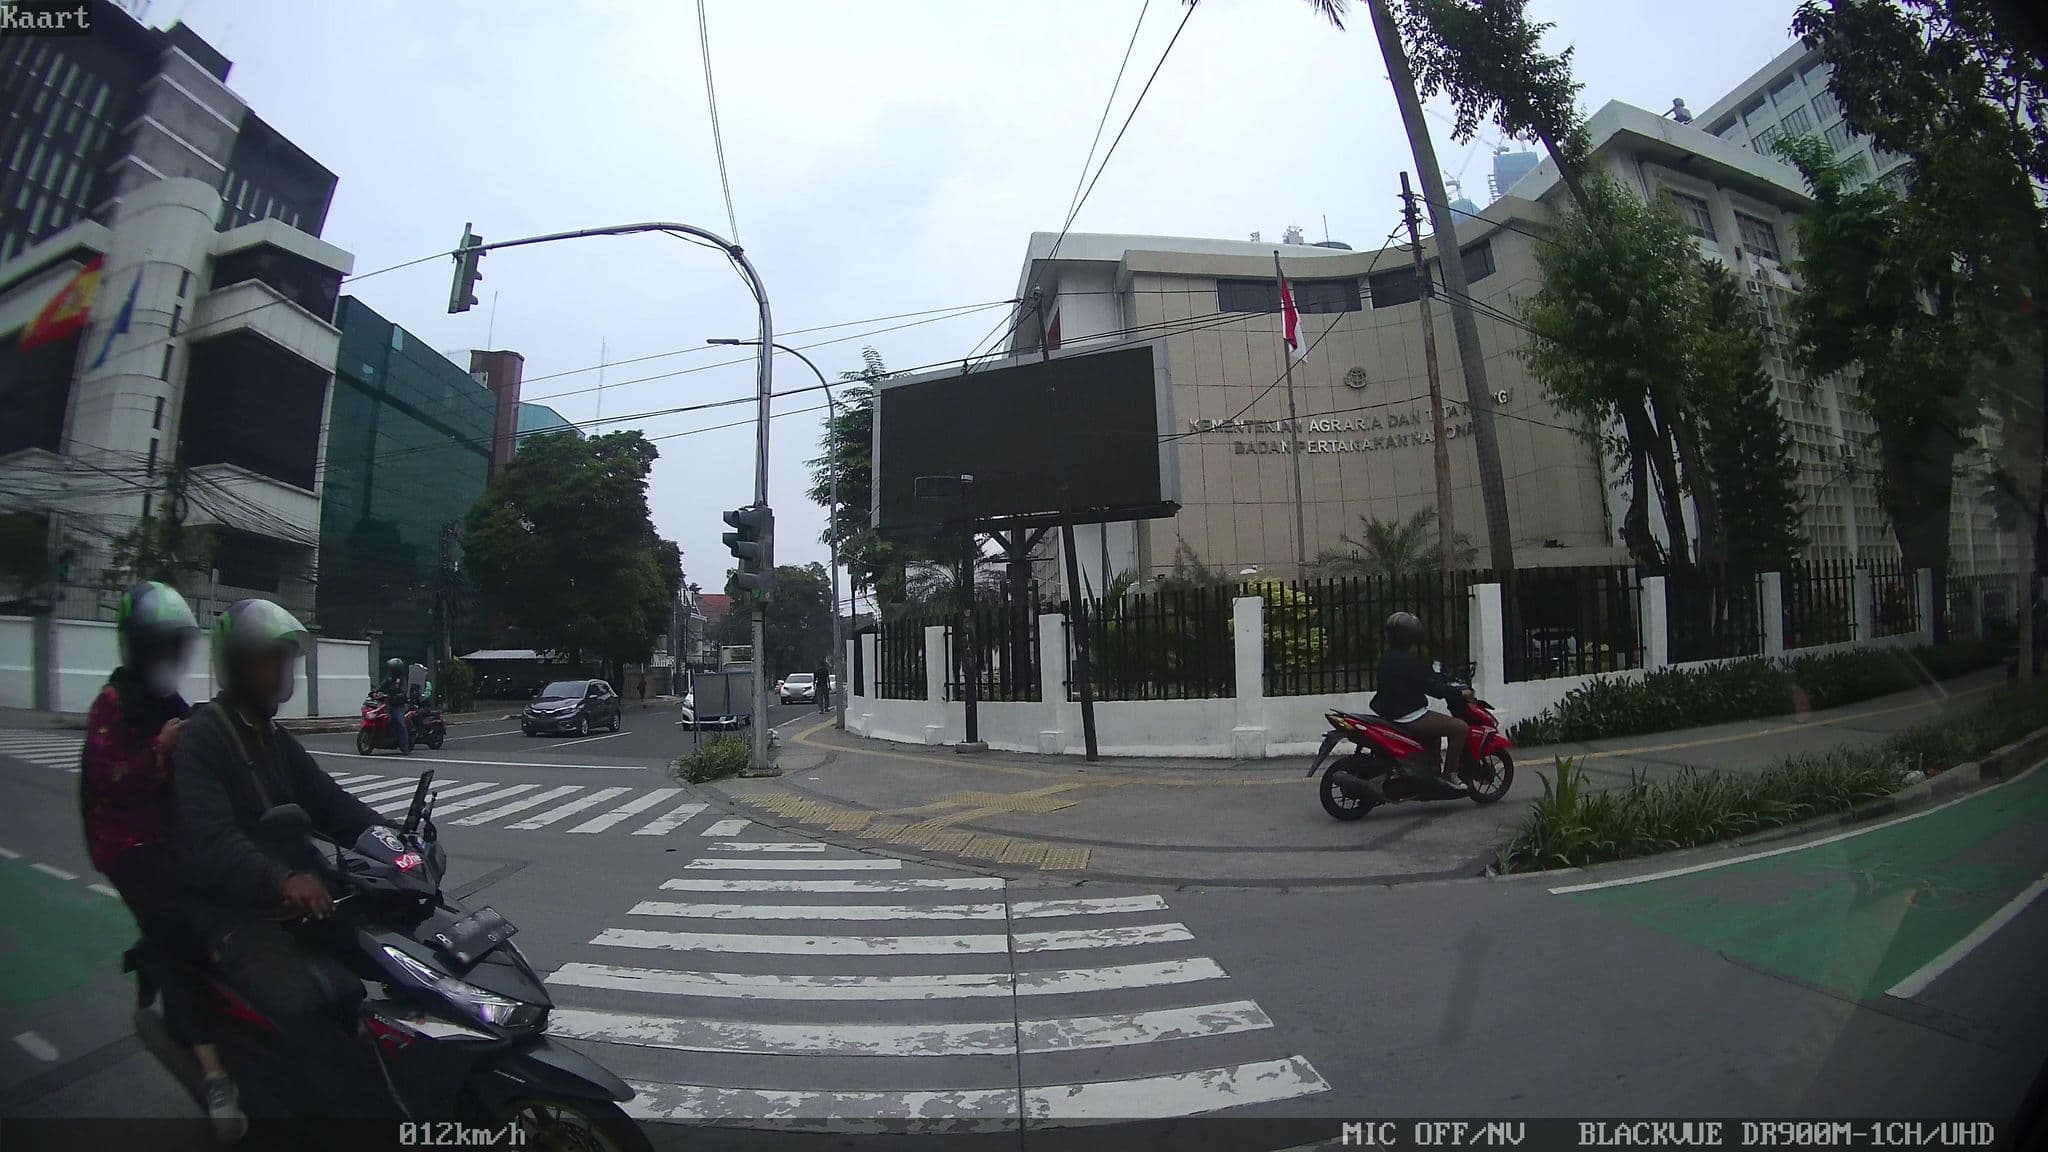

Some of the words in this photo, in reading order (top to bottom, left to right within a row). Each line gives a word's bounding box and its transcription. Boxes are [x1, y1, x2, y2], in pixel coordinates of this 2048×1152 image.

[1188, 418, 1303, 434] KEMENTERIAN
[1308, 416, 1383, 433] AGRARIA
[1388, 410, 1421, 429] DAN
[1425, 404, 1460, 423] TTA
[1234, 440, 1291, 455] BADAN
[1297, 433, 1408, 454] PERTANAHAN
